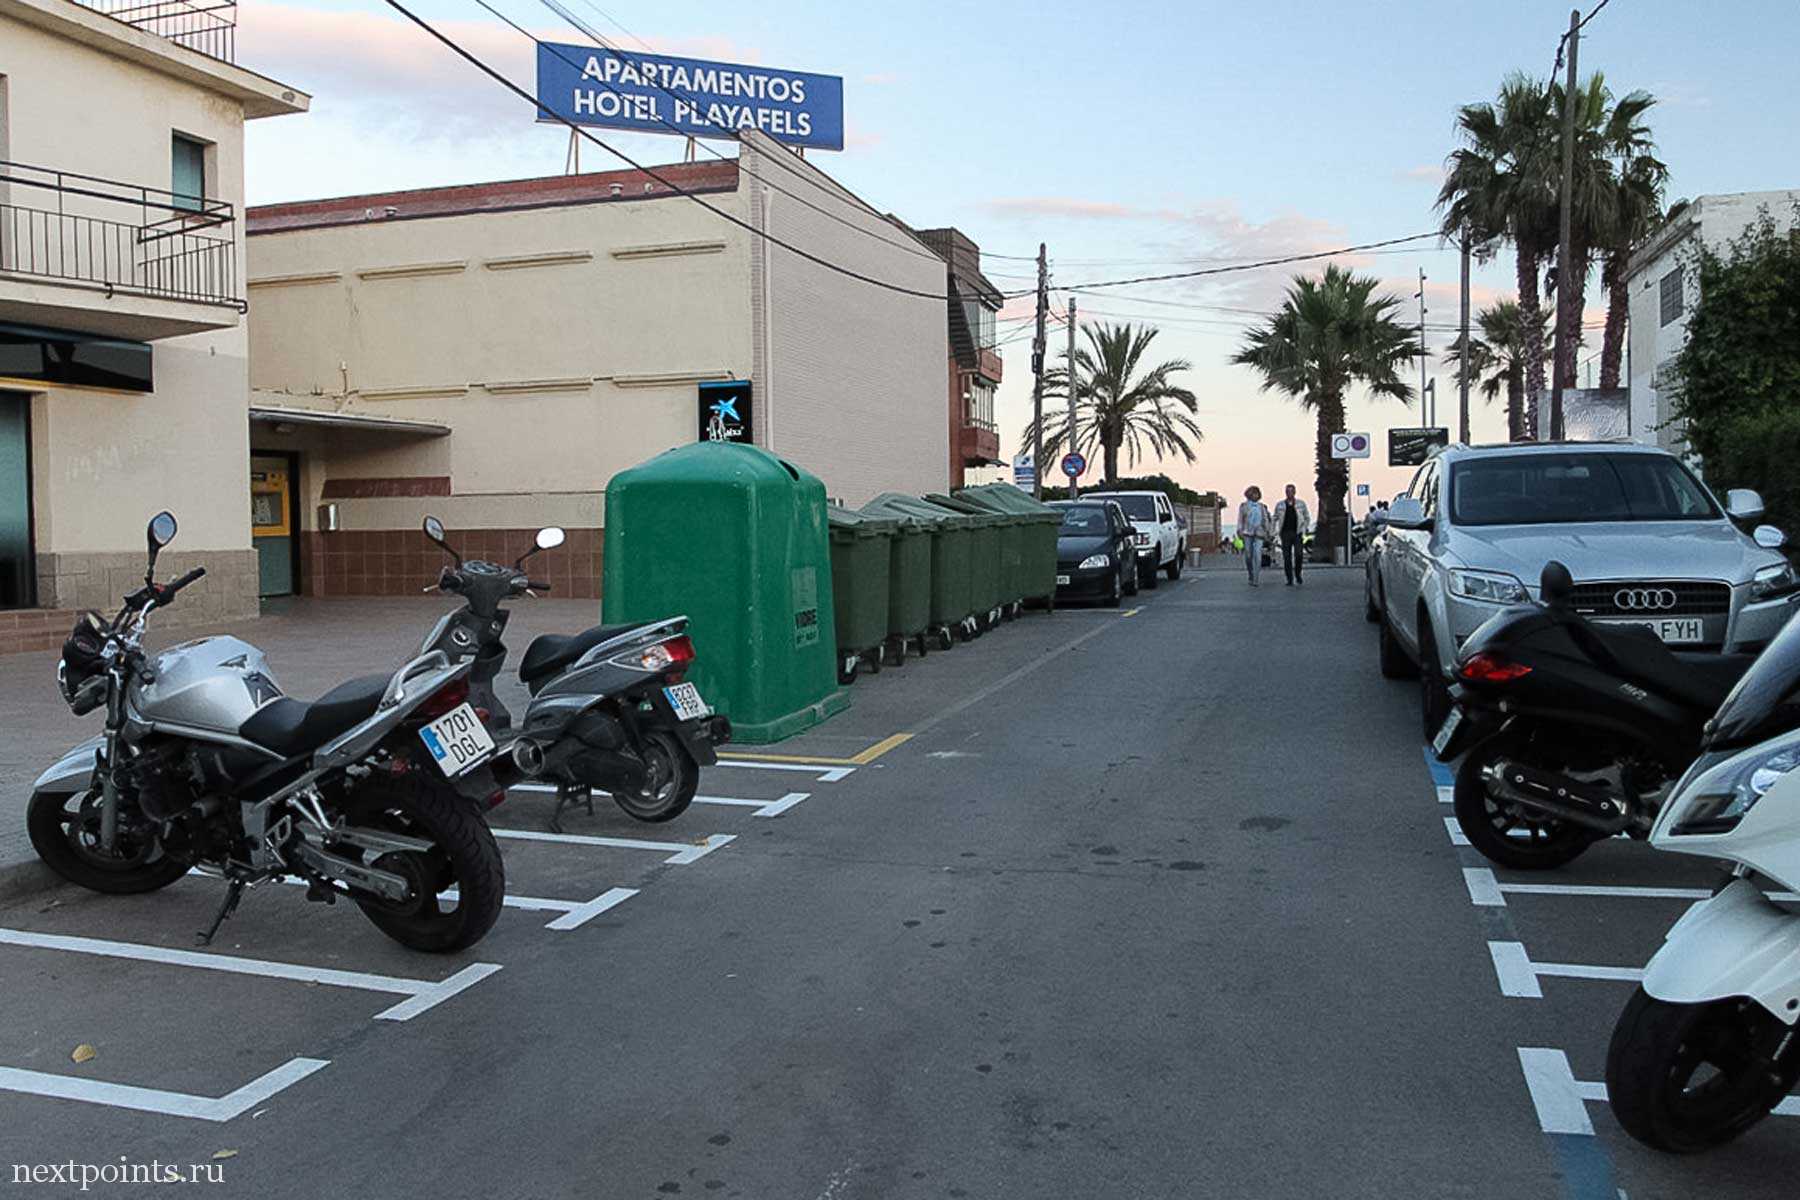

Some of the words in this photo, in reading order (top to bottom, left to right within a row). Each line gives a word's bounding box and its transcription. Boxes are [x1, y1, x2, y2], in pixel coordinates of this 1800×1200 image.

[581, 56, 806, 103] APARTAMENTOS
[574, 88, 663, 122] HOTEL
[674, 99, 812, 136] PLAYAFELS
[1661, 621, 1698, 639] FYH
[436, 709, 475, 742] 1701
[449, 734, 486, 764] DGL
